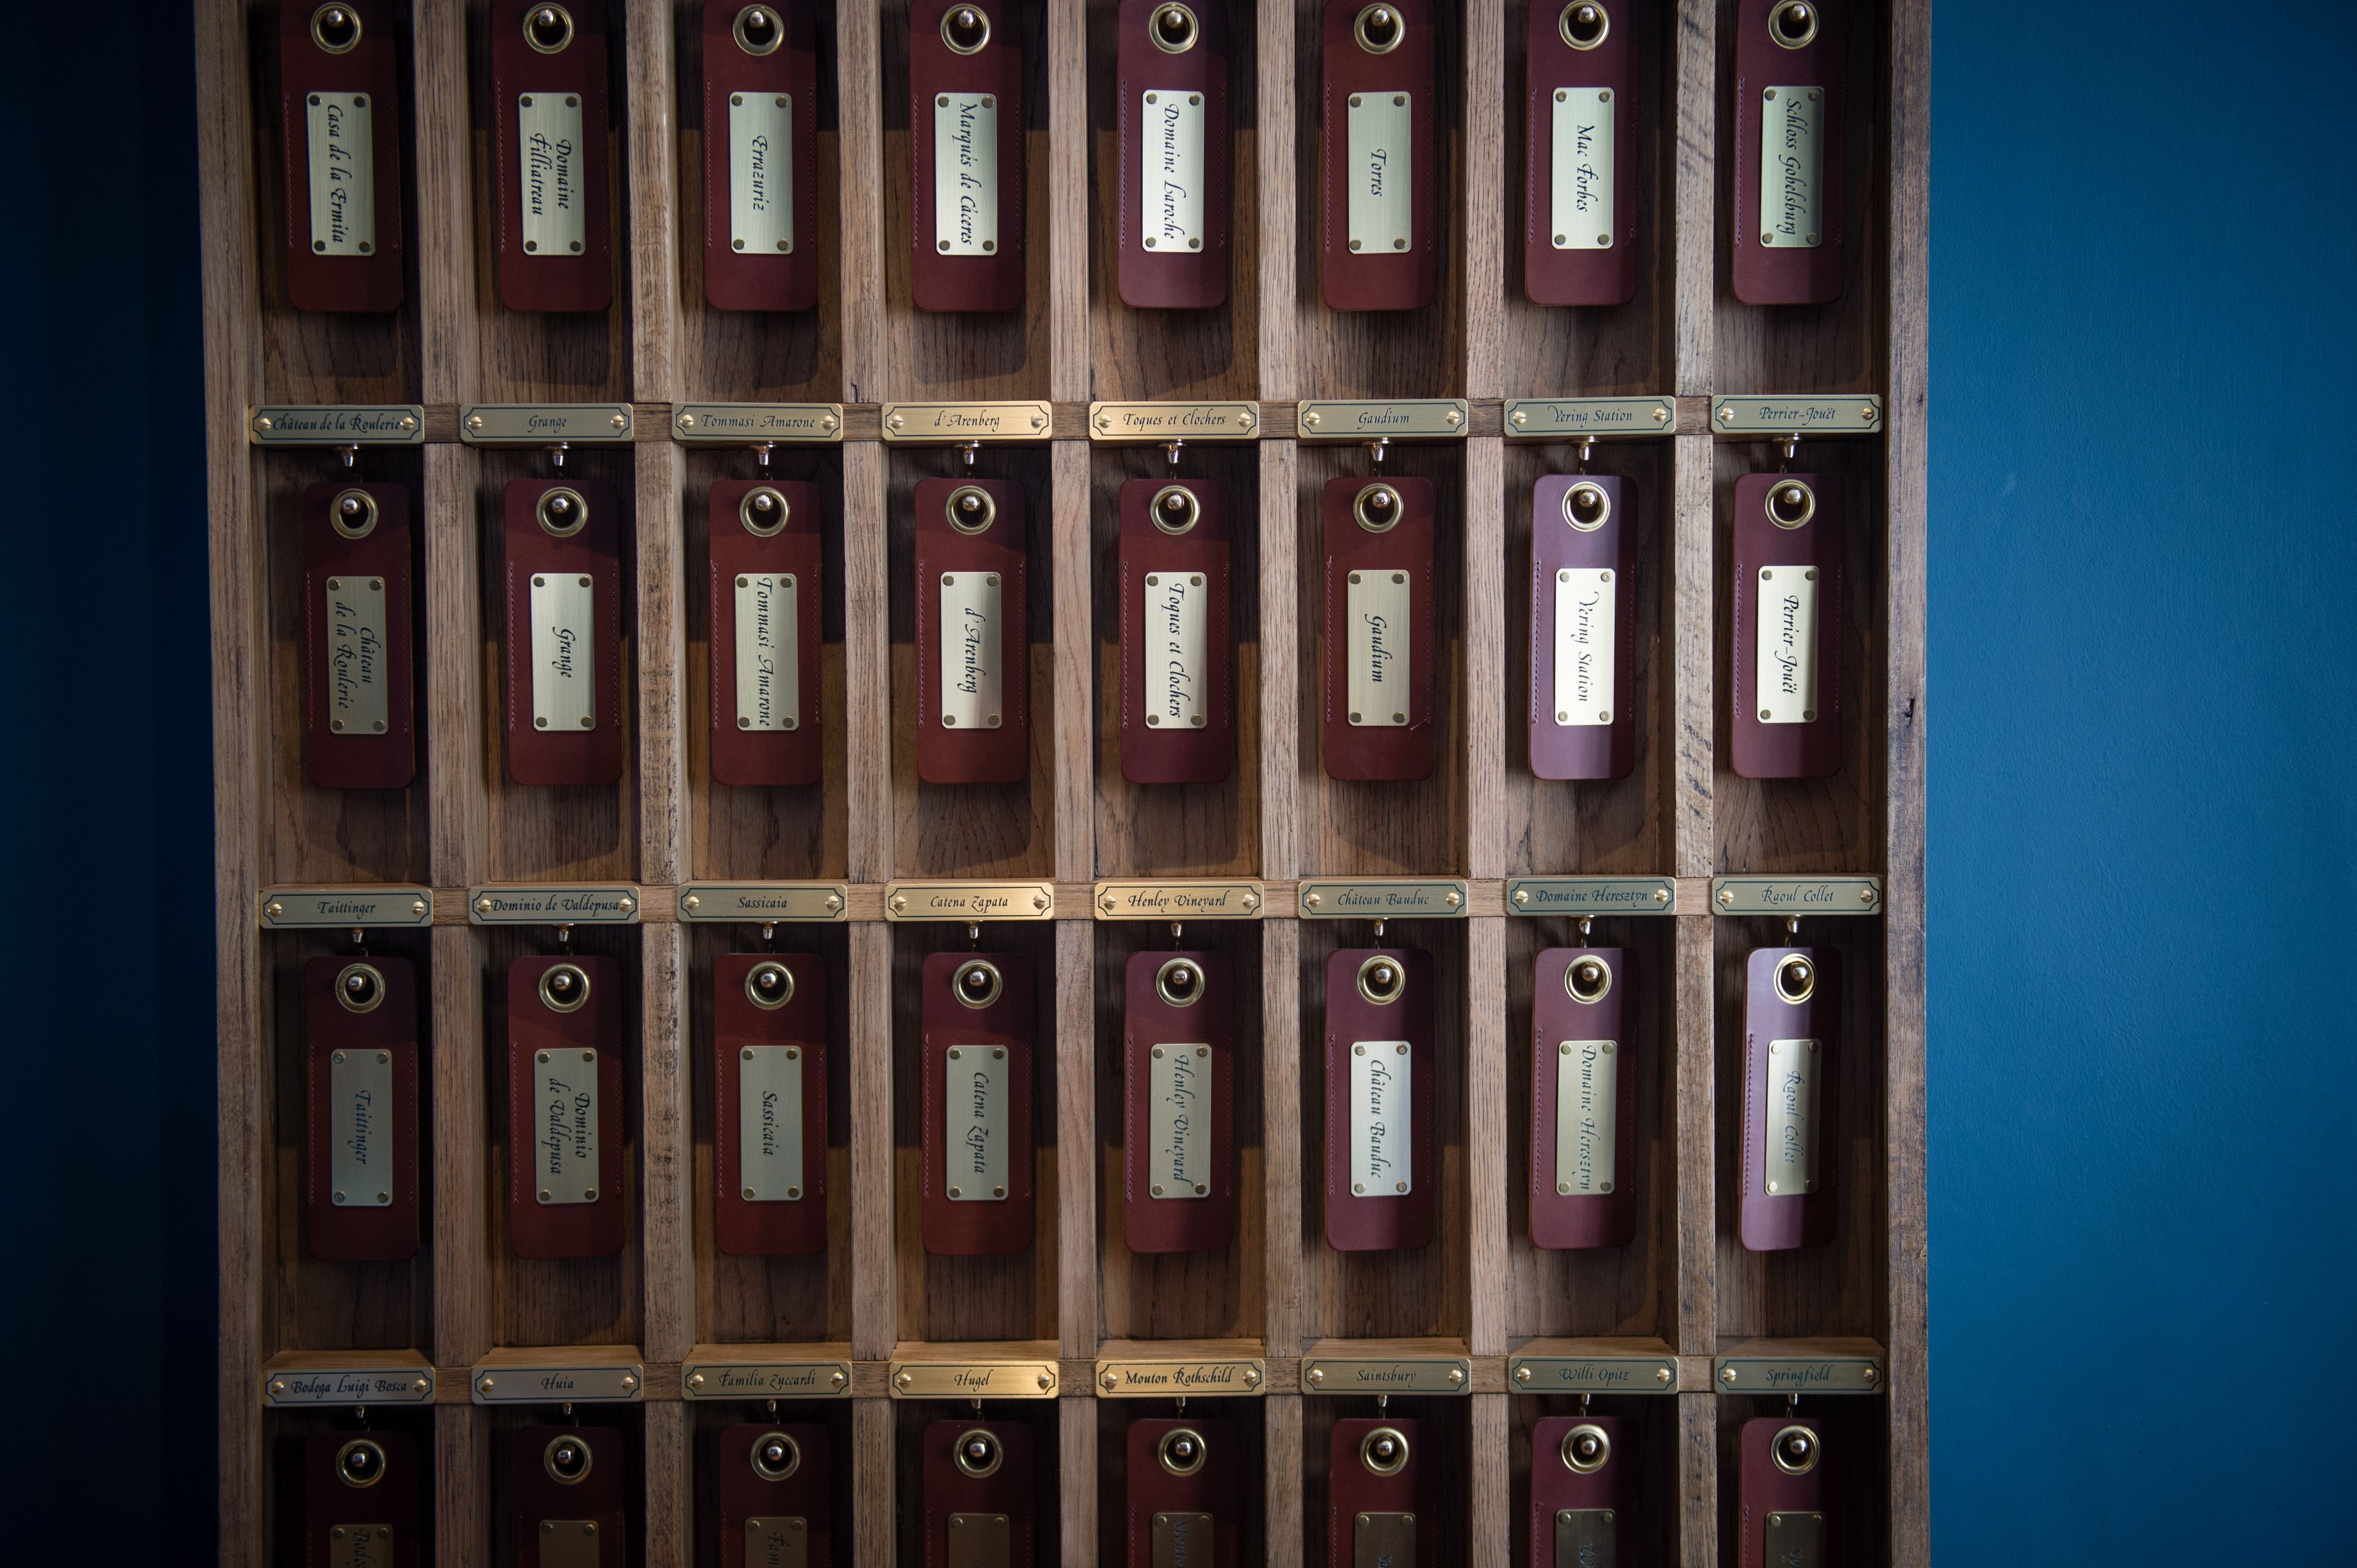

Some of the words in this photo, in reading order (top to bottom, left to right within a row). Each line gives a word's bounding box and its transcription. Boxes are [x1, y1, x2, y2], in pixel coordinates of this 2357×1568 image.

[327, 104, 343, 137] Casa
[951, 103, 977, 166] Marqués
[1164, 104, 1181, 172] Domaine
[1577, 125, 1595, 156] Mac
[1786, 99, 1807, 149] Schloss
[329, 144, 351, 160] de
[330, 167, 352, 181] la
[530, 133, 552, 215] Filliatreau
[556, 139, 575, 209] Domaine
[752, 136, 769, 211] Errazuriz
[1371, 149, 1386, 196] Torres
[961, 172, 981, 188] de
[1577, 164, 1598, 212] Forbes
[1776, 155, 1806, 234] Gobelsburg
[331, 188, 349, 242] Ermita
[1164, 180, 1186, 239] Laroche
[273, 415, 316, 431] Château
[320, 417, 331, 430] de
[335, 415, 345, 430] la
[350, 413, 400, 433] Roulerie
[528, 415, 566, 430] Grange
[701, 414, 754, 427] Tommasi
[759, 415, 815, 428] Amarone
[1123, 414, 1163, 431] Toques
[1168, 415, 1177, 425] et
[1183, 409, 1226, 425] Clochers
[1357, 408, 1409, 429] Gaudium
[1547, 405, 1587, 429] Yering
[1593, 409, 1632, 421] Station
[1760, 407, 1835, 425] Perrier-Jouët
[335, 602, 355, 617] de
[336, 624, 356, 636] la
[757, 577, 775, 647] Tommasi
[1161, 583, 1184, 635] Toques
[1571, 592, 1599, 644] Yering
[360, 627, 381, 684] Château
[552, 627, 575, 678] Grange
[1169, 642, 1182, 654] et
[1365, 614, 1392, 682] Gaudium
[1775, 595, 1799, 693] Perrier-Jouët
[333, 644, 358, 708] Roulerie
[758, 655, 773, 726] Amarone
[1169, 661, 1190, 717] Clochers
[1578, 651, 1593, 701] Station
[318, 901, 376, 919] Taittinger
[492, 898, 541, 911] Dominio
[545, 895, 557, 911] de
[560, 895, 619, 917] Valdepusa
[738, 896, 787, 908] Sassicaia
[931, 896, 965, 908] Catena
[971, 896, 1008, 913] Zapata
[1128, 890, 1169, 912] Henley
[1174, 890, 1228, 912] Vineyard
[1385, 890, 1429, 905] Bauduc
[1536, 889, 1586, 902] Domaine
[1591, 887, 1648, 907] Heresztyn
[1762, 886, 1799, 904] Raoul
[1803, 887, 1833, 902] Collet
[549, 1078, 570, 1093] de
[974, 1073, 989, 1118] Catena
[1166, 1055, 1195, 1108] Henley
[1371, 1060, 1391, 1114] Château
[1581, 1046, 1597, 1110] Domaine
[1782, 1070, 1804, 1121] Raoul
[348, 1090, 374, 1165] Taittinger
[542, 1101, 571, 1175] Valdepusa
[575, 1093, 592, 1158] Dominio
[762, 1091, 779, 1156] Sassicaia
[1784, 1125, 1803, 1164] Collet
[966, 1125, 988, 1173] Zapata
[1166, 1114, 1193, 1186] Vineyard
[1370, 1122, 1391, 1178] Bauduc
[291, 1377, 331, 1399] Bodega
[336, 1375, 370, 1397] Luigi
[375, 1380, 407, 1392] Bosca
[541, 1373, 573, 1389] Huia
[719, 1370, 764, 1387] Familia
[770, 1371, 815, 1391] Zuccardi
[954, 1373, 991, 1391] Hugel
[1125, 1370, 1168, 1383] Mouton
[1173, 1367, 1235, 1386] Rothschild
[1357, 1368, 1416, 1388] Saintsbury
[1559, 1364, 1594, 1380] Willi
[1599, 1367, 1628, 1385] Opitz
[1766, 1365, 1830, 1387] Springfield
